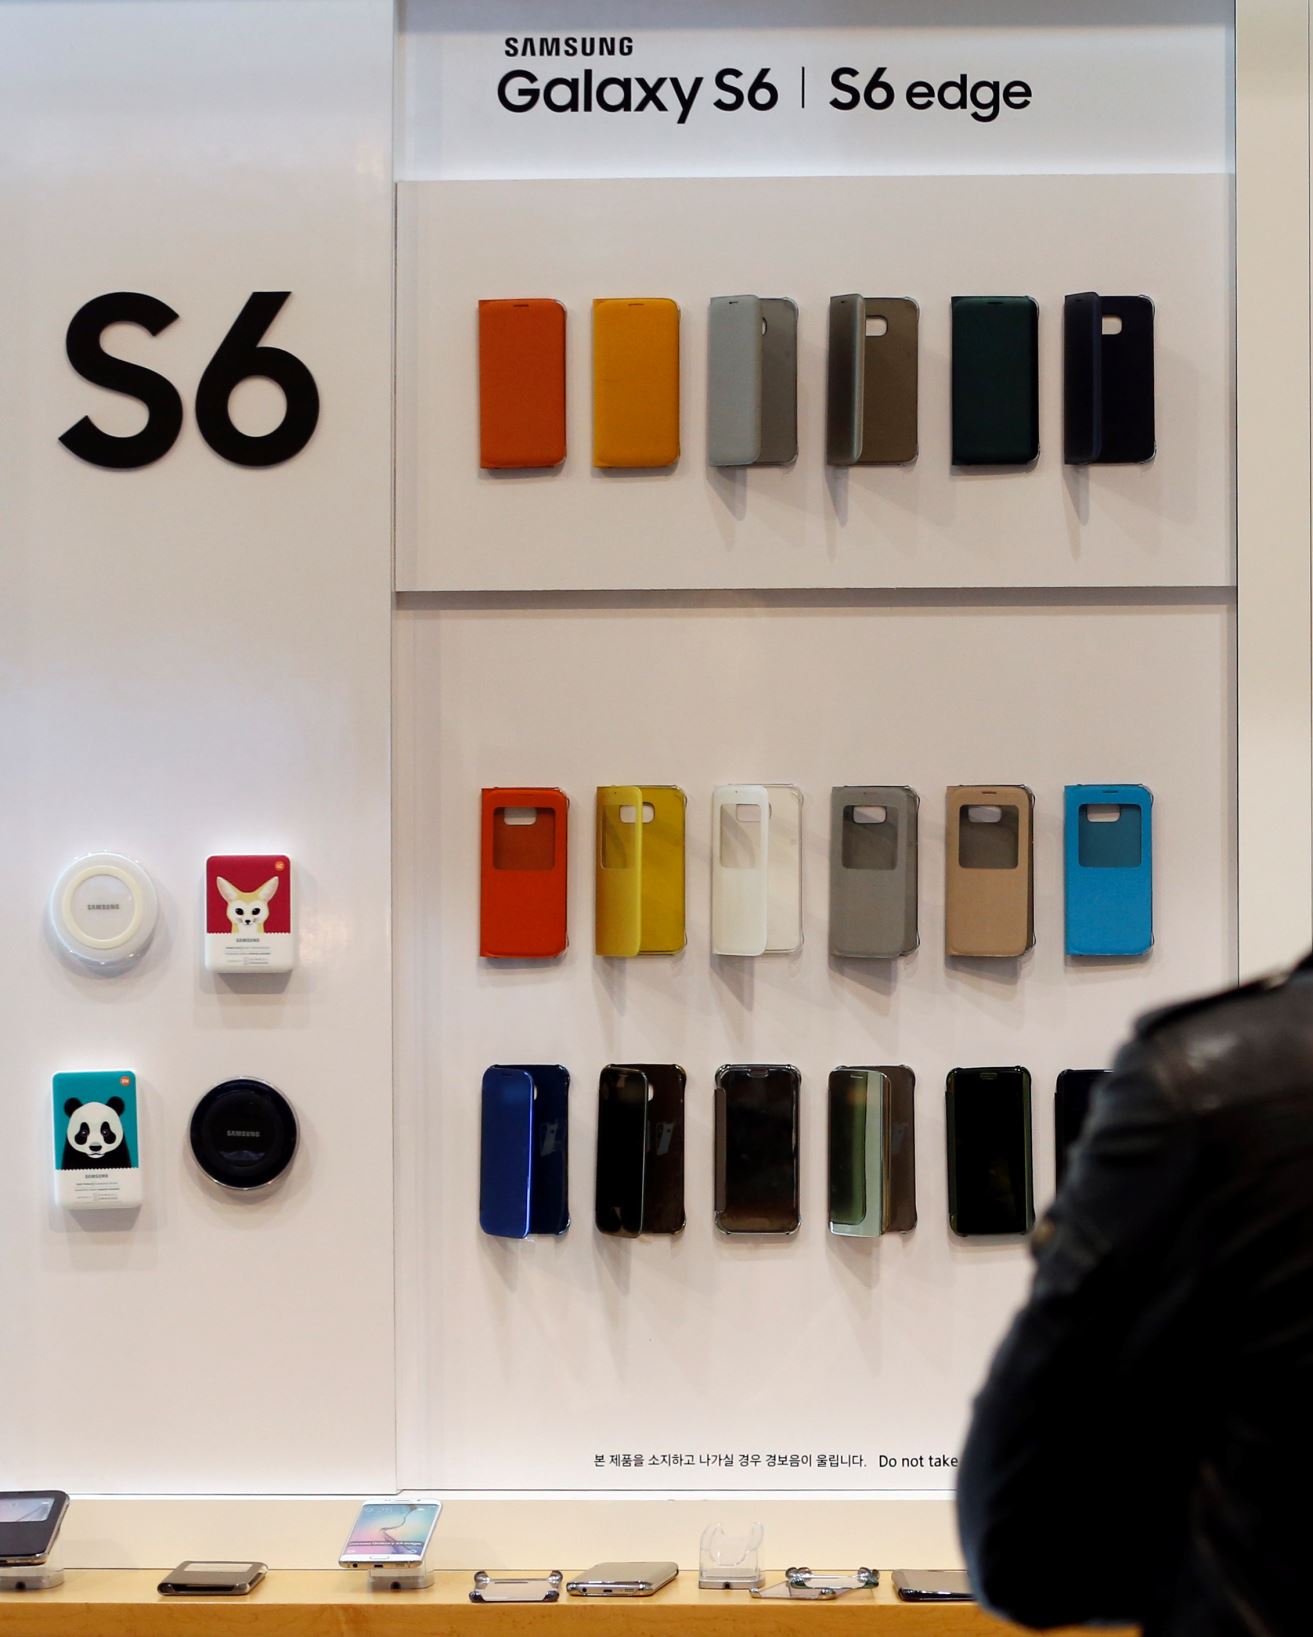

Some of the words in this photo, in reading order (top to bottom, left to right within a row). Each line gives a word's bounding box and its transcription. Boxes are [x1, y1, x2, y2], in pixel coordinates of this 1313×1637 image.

[504, 37, 633, 57] SAMSUNG
[498, 68, 704, 125] Galaxy
[713, 67, 779, 111] S6
[829, 66, 895, 111] S6
[905, 73, 1033, 123] edge
[58, 291, 320, 470] S6
[593, 1453, 605, 1468] 본
[609, 1453, 645, 1468] 제품을
[648, 1453, 696, 1468] 소지하고
[699, 1453, 734, 1468] 나가실
[738, 1453, 762, 1468] 경우
[765, 1453, 812, 1468] 경보음이
[816, 1453, 867, 1468] 울립니다.
[879, 1455, 898, 1467] Do
[902, 1455, 925, 1467] not
[929, 1455, 959, 1467] take
